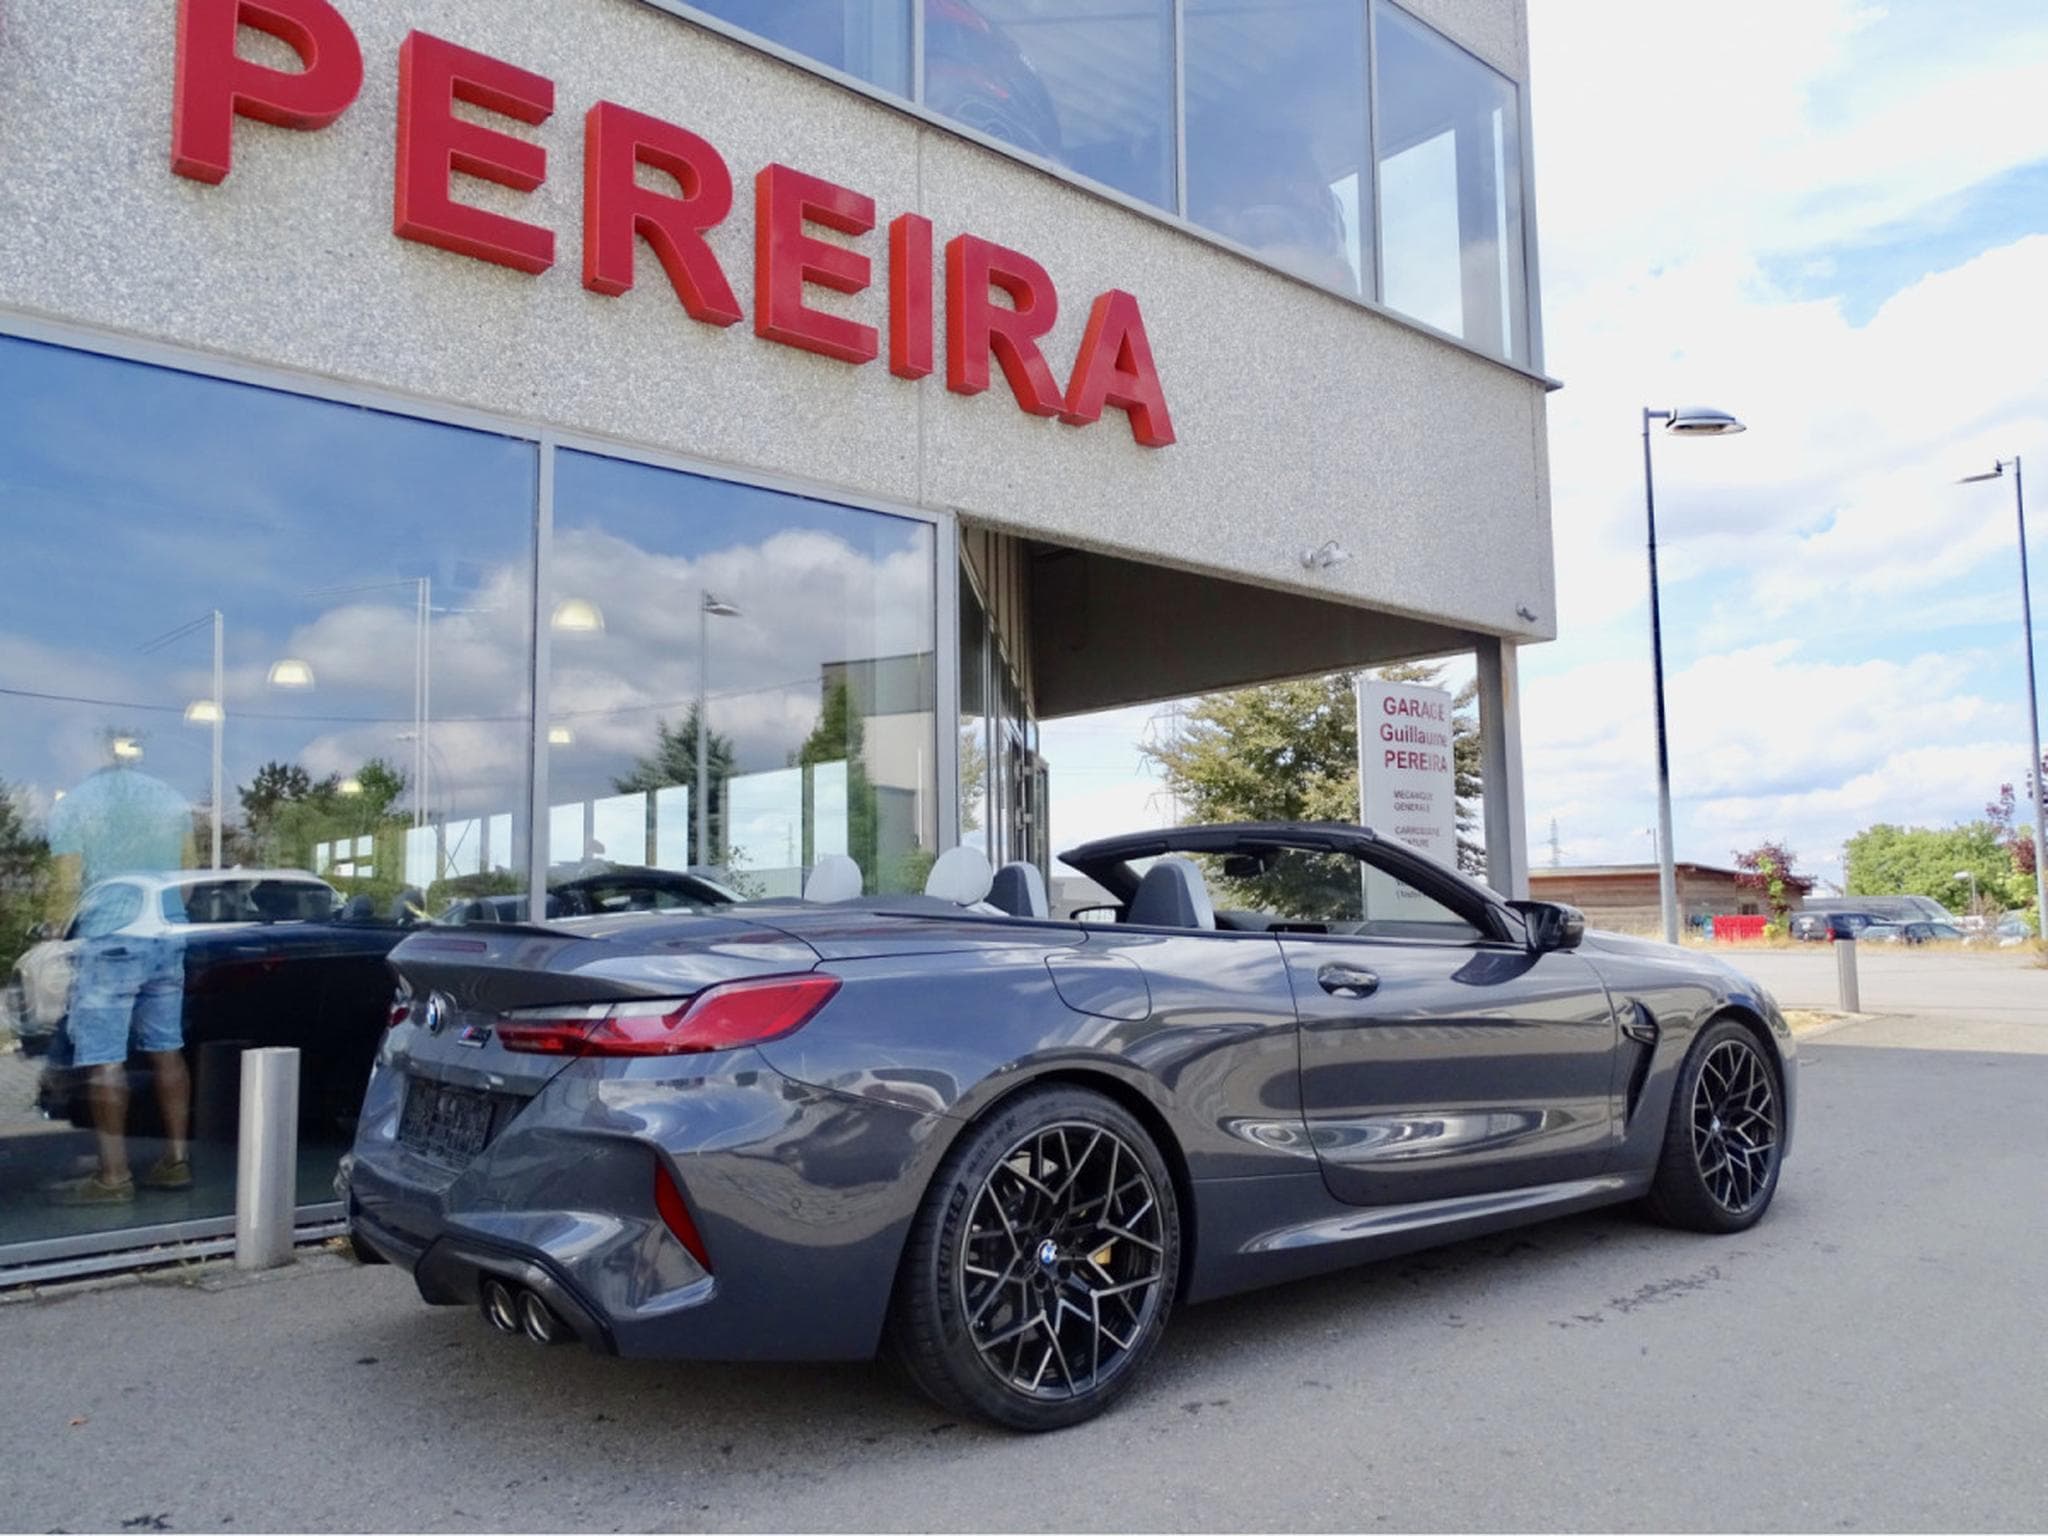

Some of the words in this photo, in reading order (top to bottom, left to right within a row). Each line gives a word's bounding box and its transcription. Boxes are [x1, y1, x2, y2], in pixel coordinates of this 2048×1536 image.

[170, 0, 1176, 448] PEREIRA
[1383, 696, 1445, 721] GARAGE
[1380, 723, 1447, 747] Guillaume
[1384, 750, 1448, 772] PEREIRA
